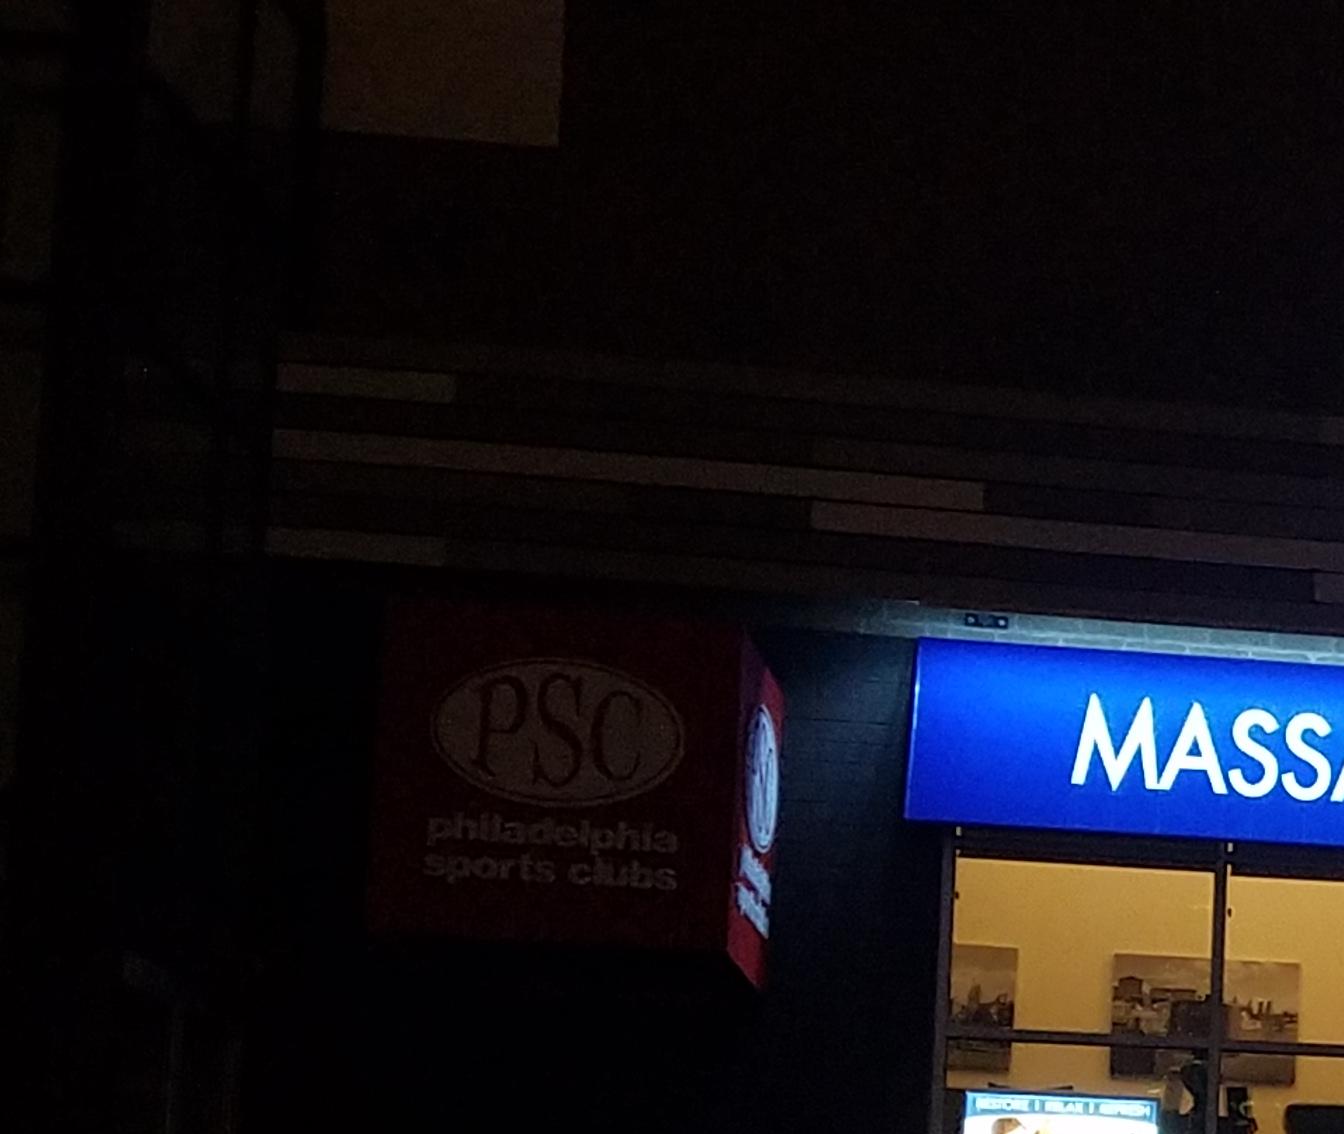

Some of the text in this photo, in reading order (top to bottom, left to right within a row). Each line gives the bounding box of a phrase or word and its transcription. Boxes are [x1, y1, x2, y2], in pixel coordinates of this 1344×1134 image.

[472, 672, 643, 788] PSC
[425, 811, 679, 854] philadelphia
[422, 851, 678, 891] sports clubs
